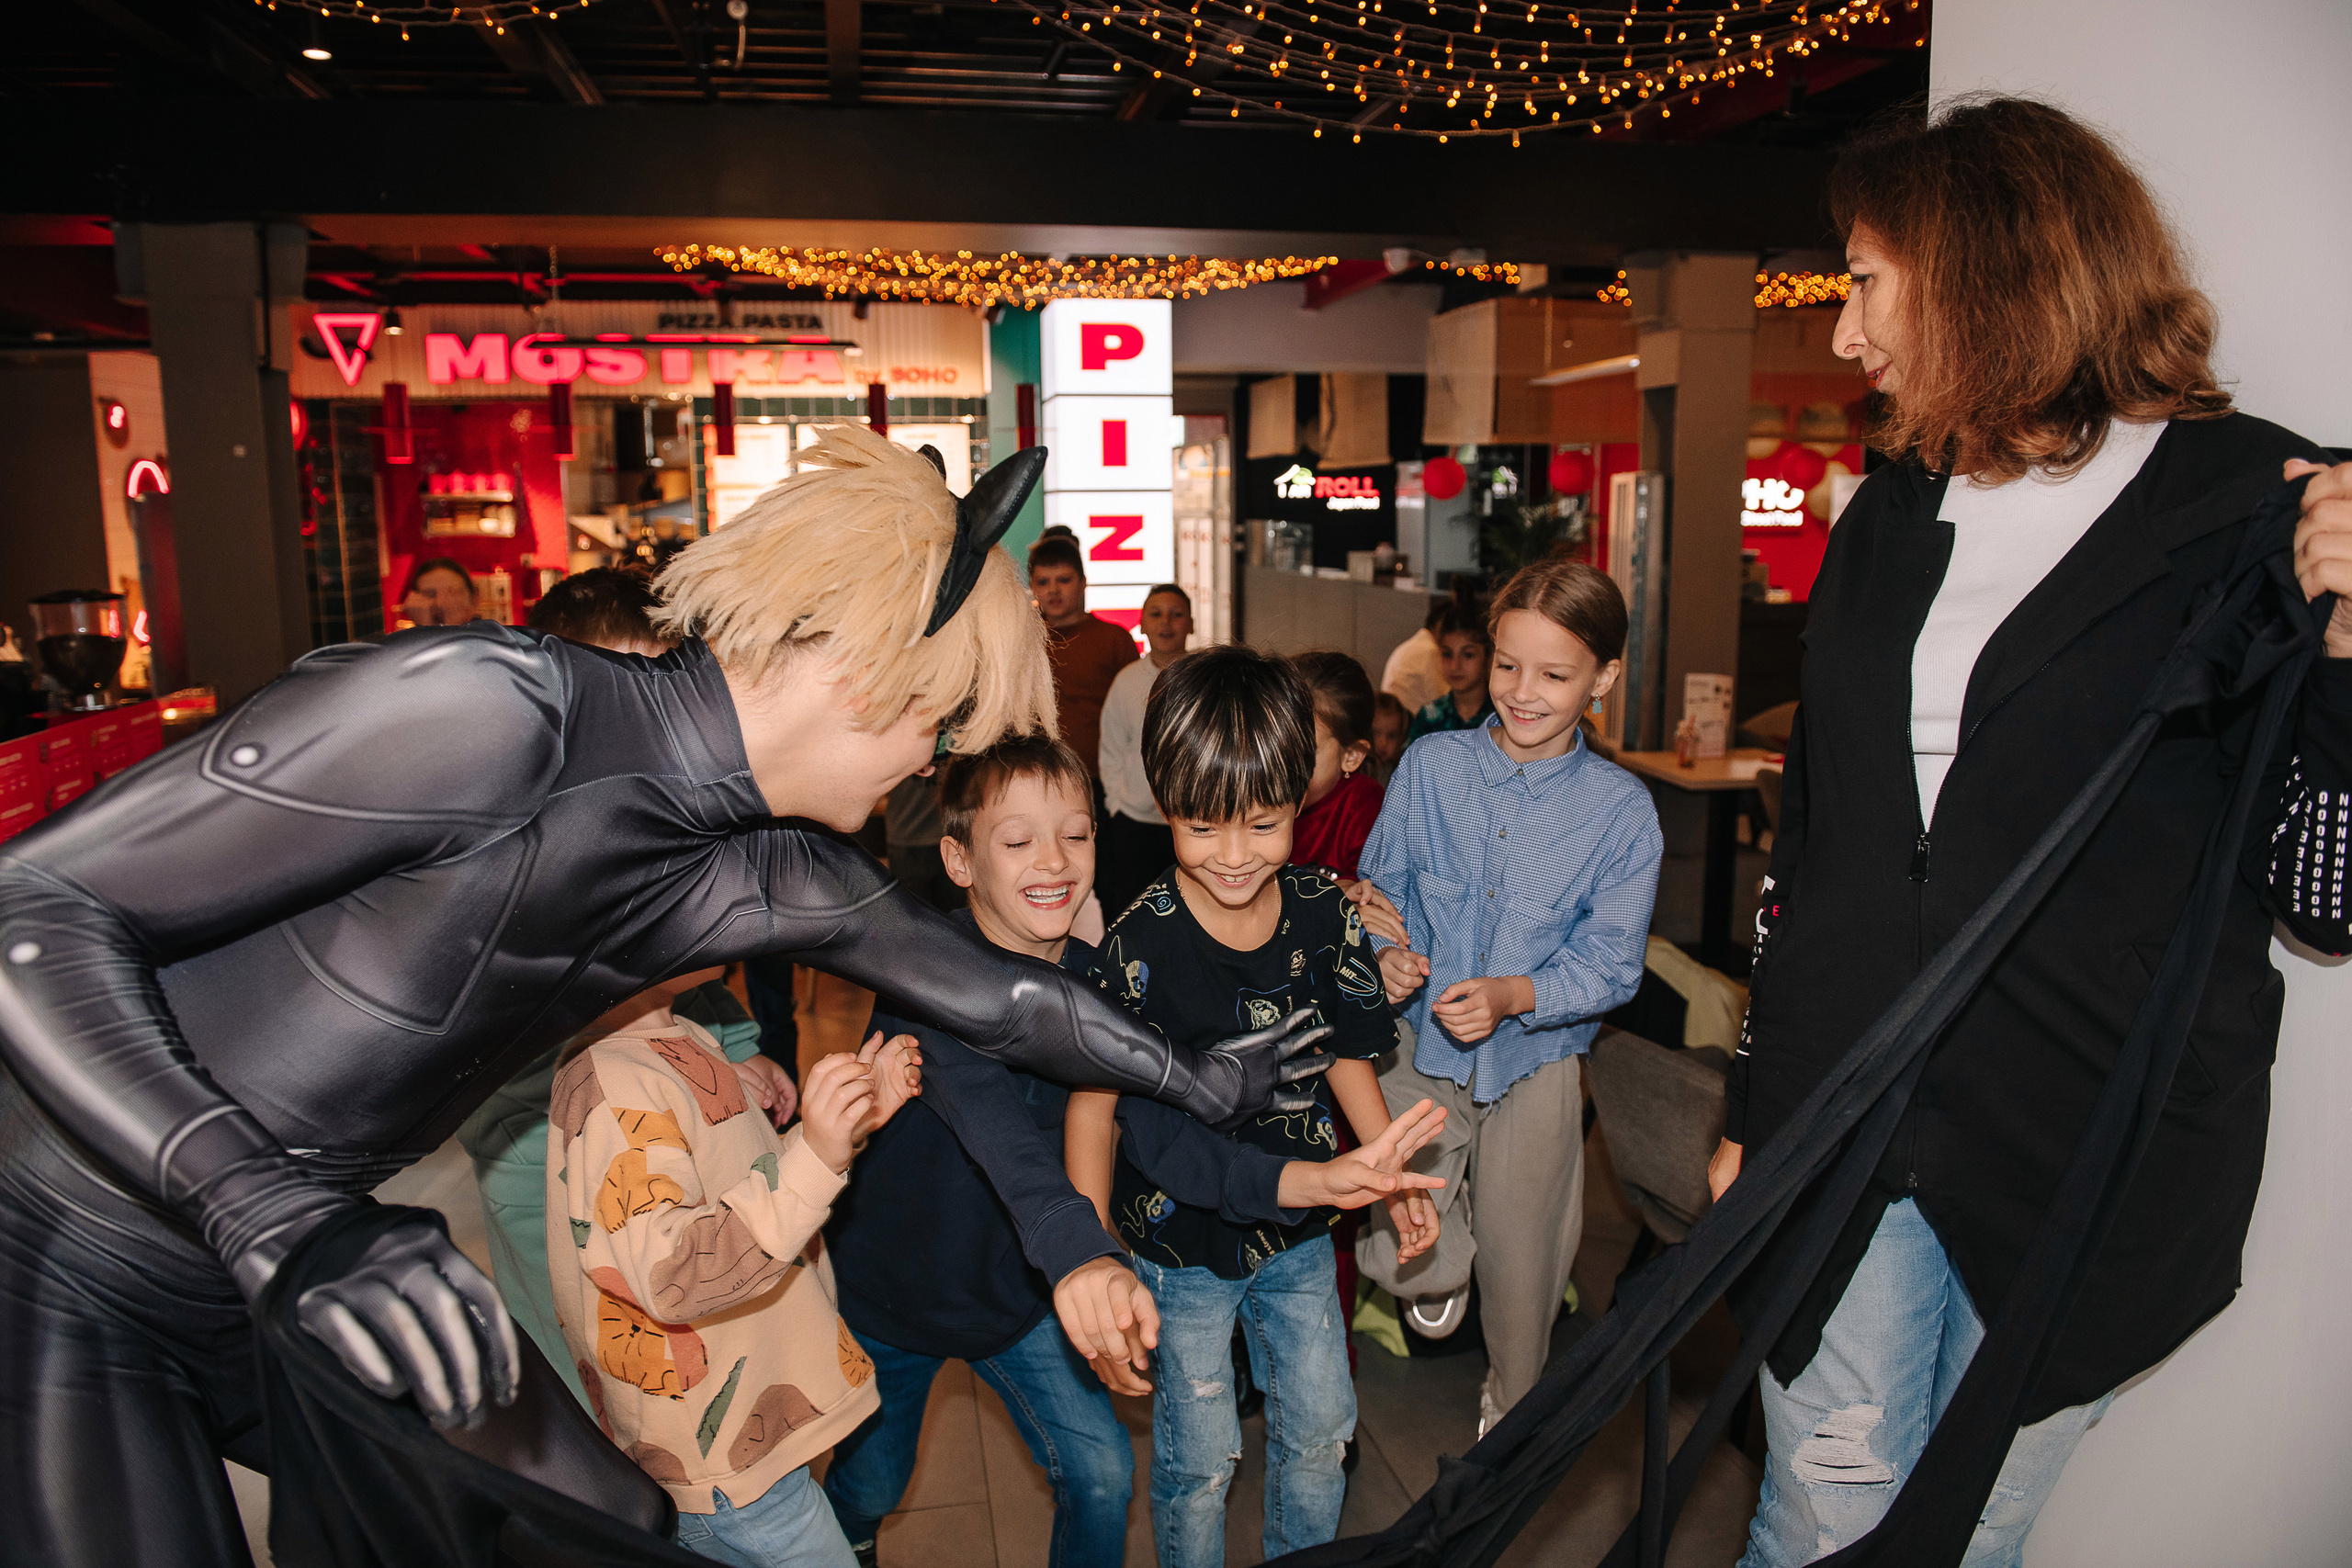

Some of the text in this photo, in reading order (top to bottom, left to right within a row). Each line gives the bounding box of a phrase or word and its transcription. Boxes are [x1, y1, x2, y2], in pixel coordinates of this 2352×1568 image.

[742, 312, 823, 329] PASTA
[889, 366, 958, 385] SOHO
[1314, 476, 1381, 499] ROLL
